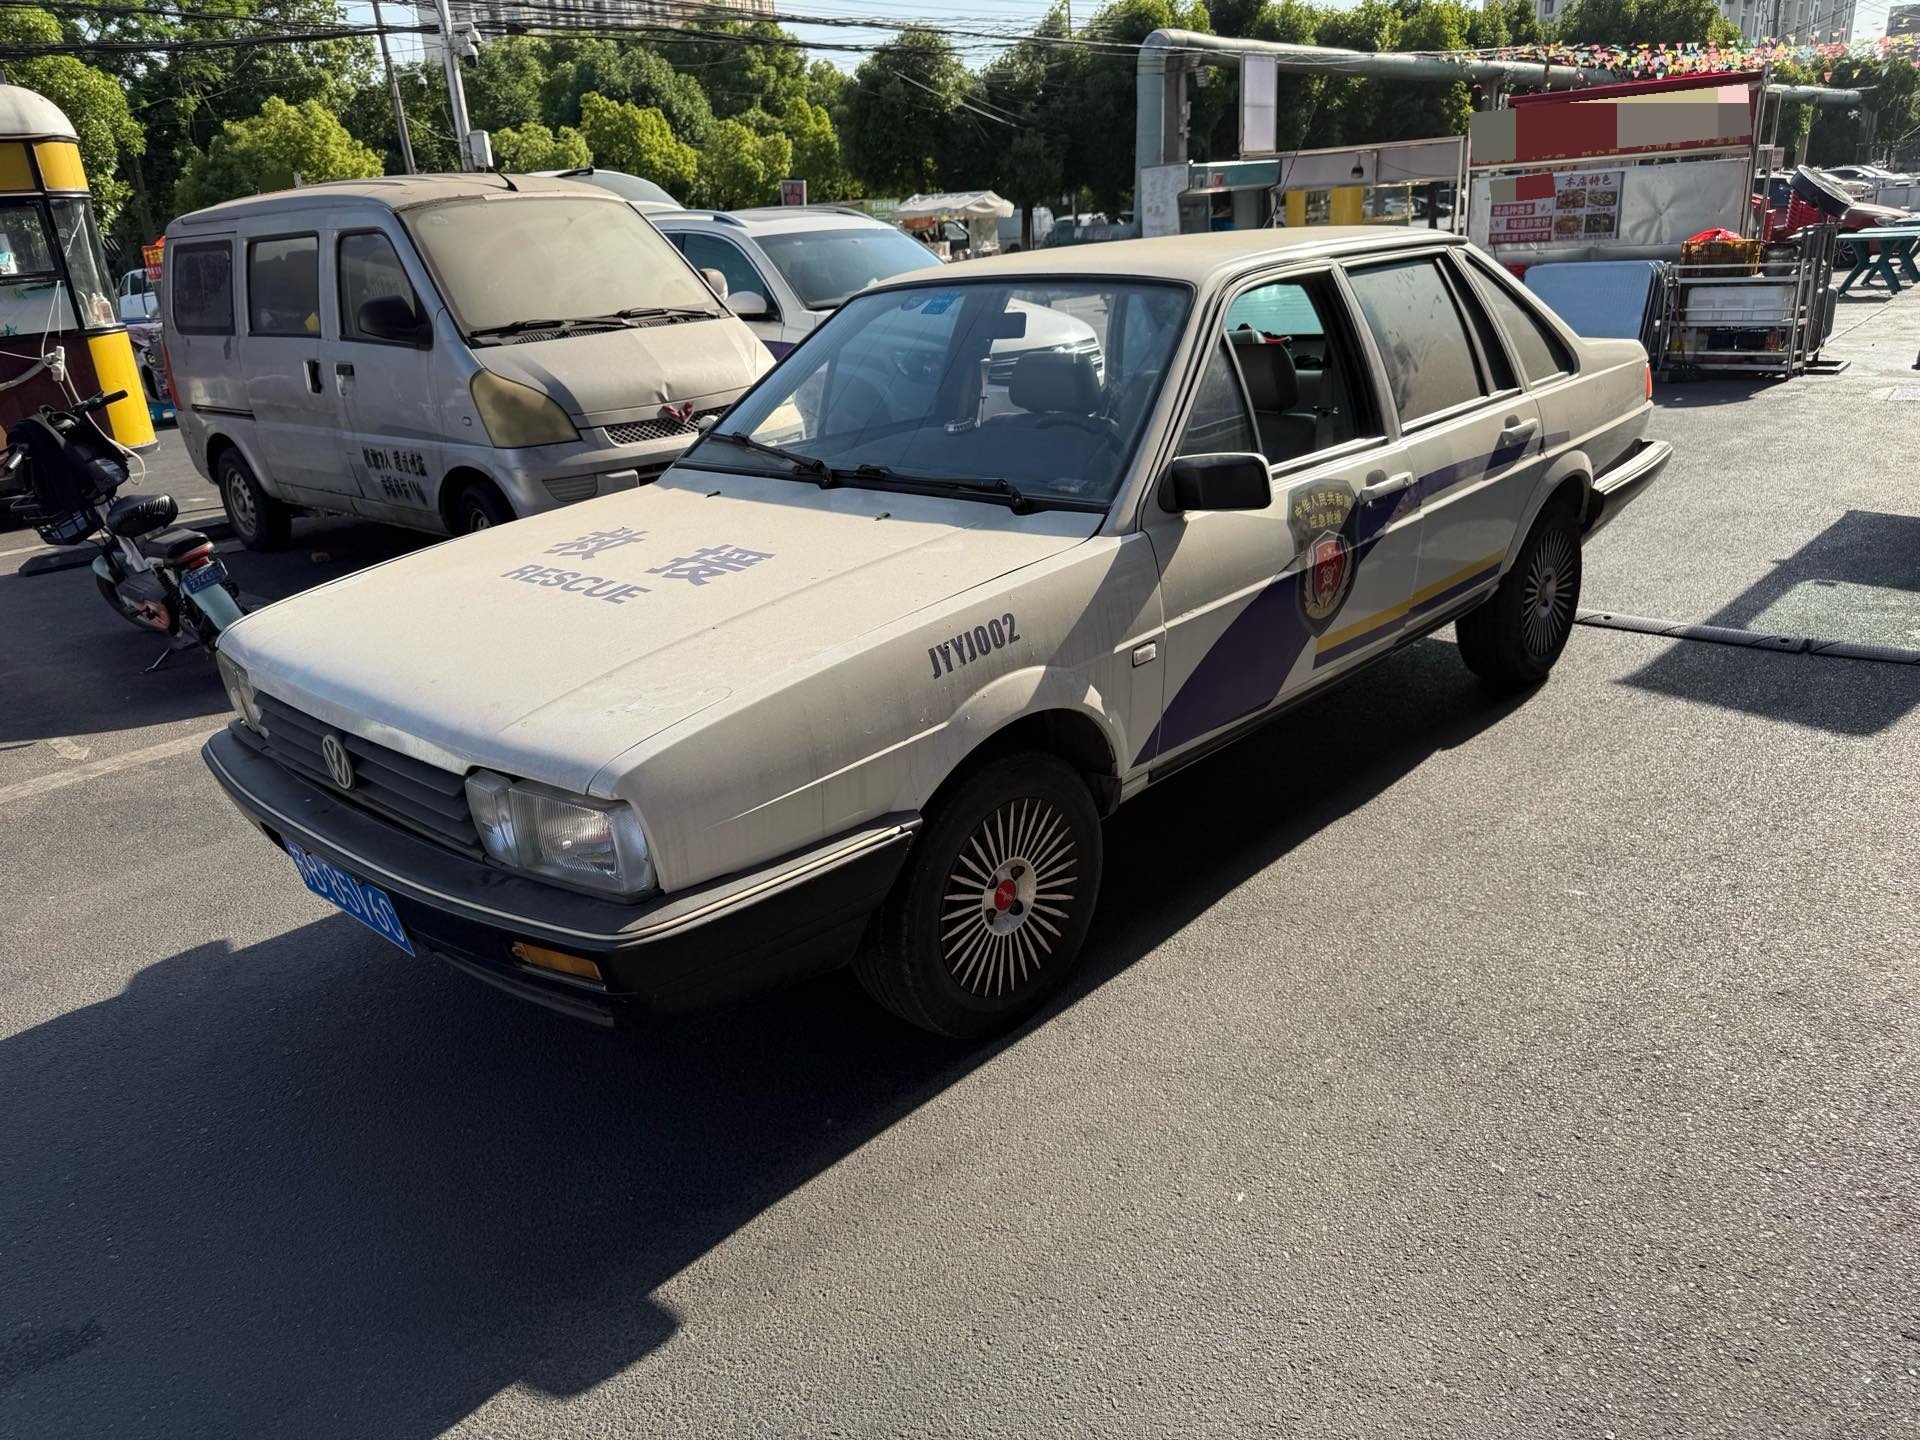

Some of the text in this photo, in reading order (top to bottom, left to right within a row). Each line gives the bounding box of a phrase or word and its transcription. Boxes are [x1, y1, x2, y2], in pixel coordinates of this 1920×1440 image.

[1565, 173, 1612, 187] 本店特色
[501, 564, 652, 604] RESCUE
[927, 613, 1021, 680] JYYJ002
